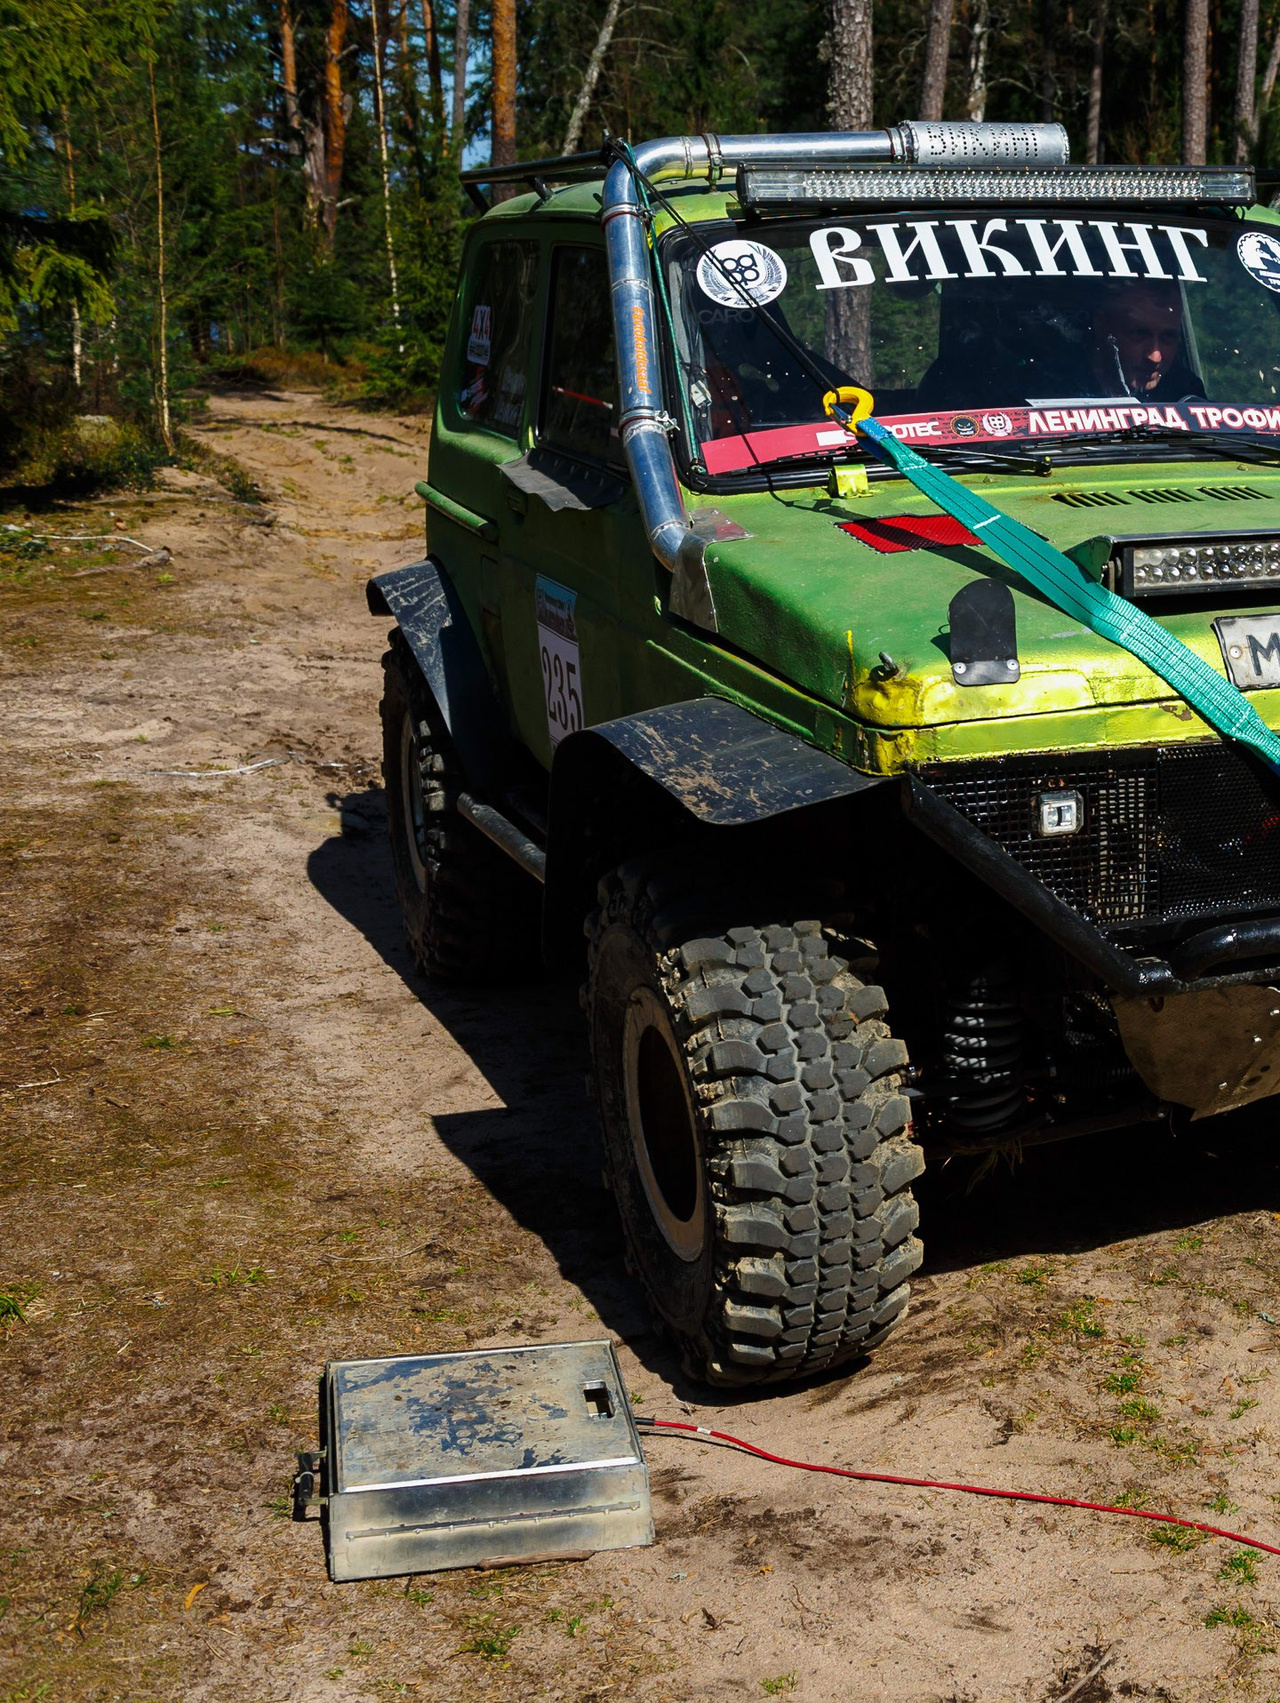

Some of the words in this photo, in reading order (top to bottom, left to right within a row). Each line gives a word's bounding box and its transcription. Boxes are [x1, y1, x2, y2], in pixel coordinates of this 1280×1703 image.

[926, 124, 1045, 157] ВИКИНГ
[809, 218, 1209, 291] ВИКИНГ
[1028, 405, 1187, 433] ЛЕНИНГРАД
[541, 646, 583, 732] 235
